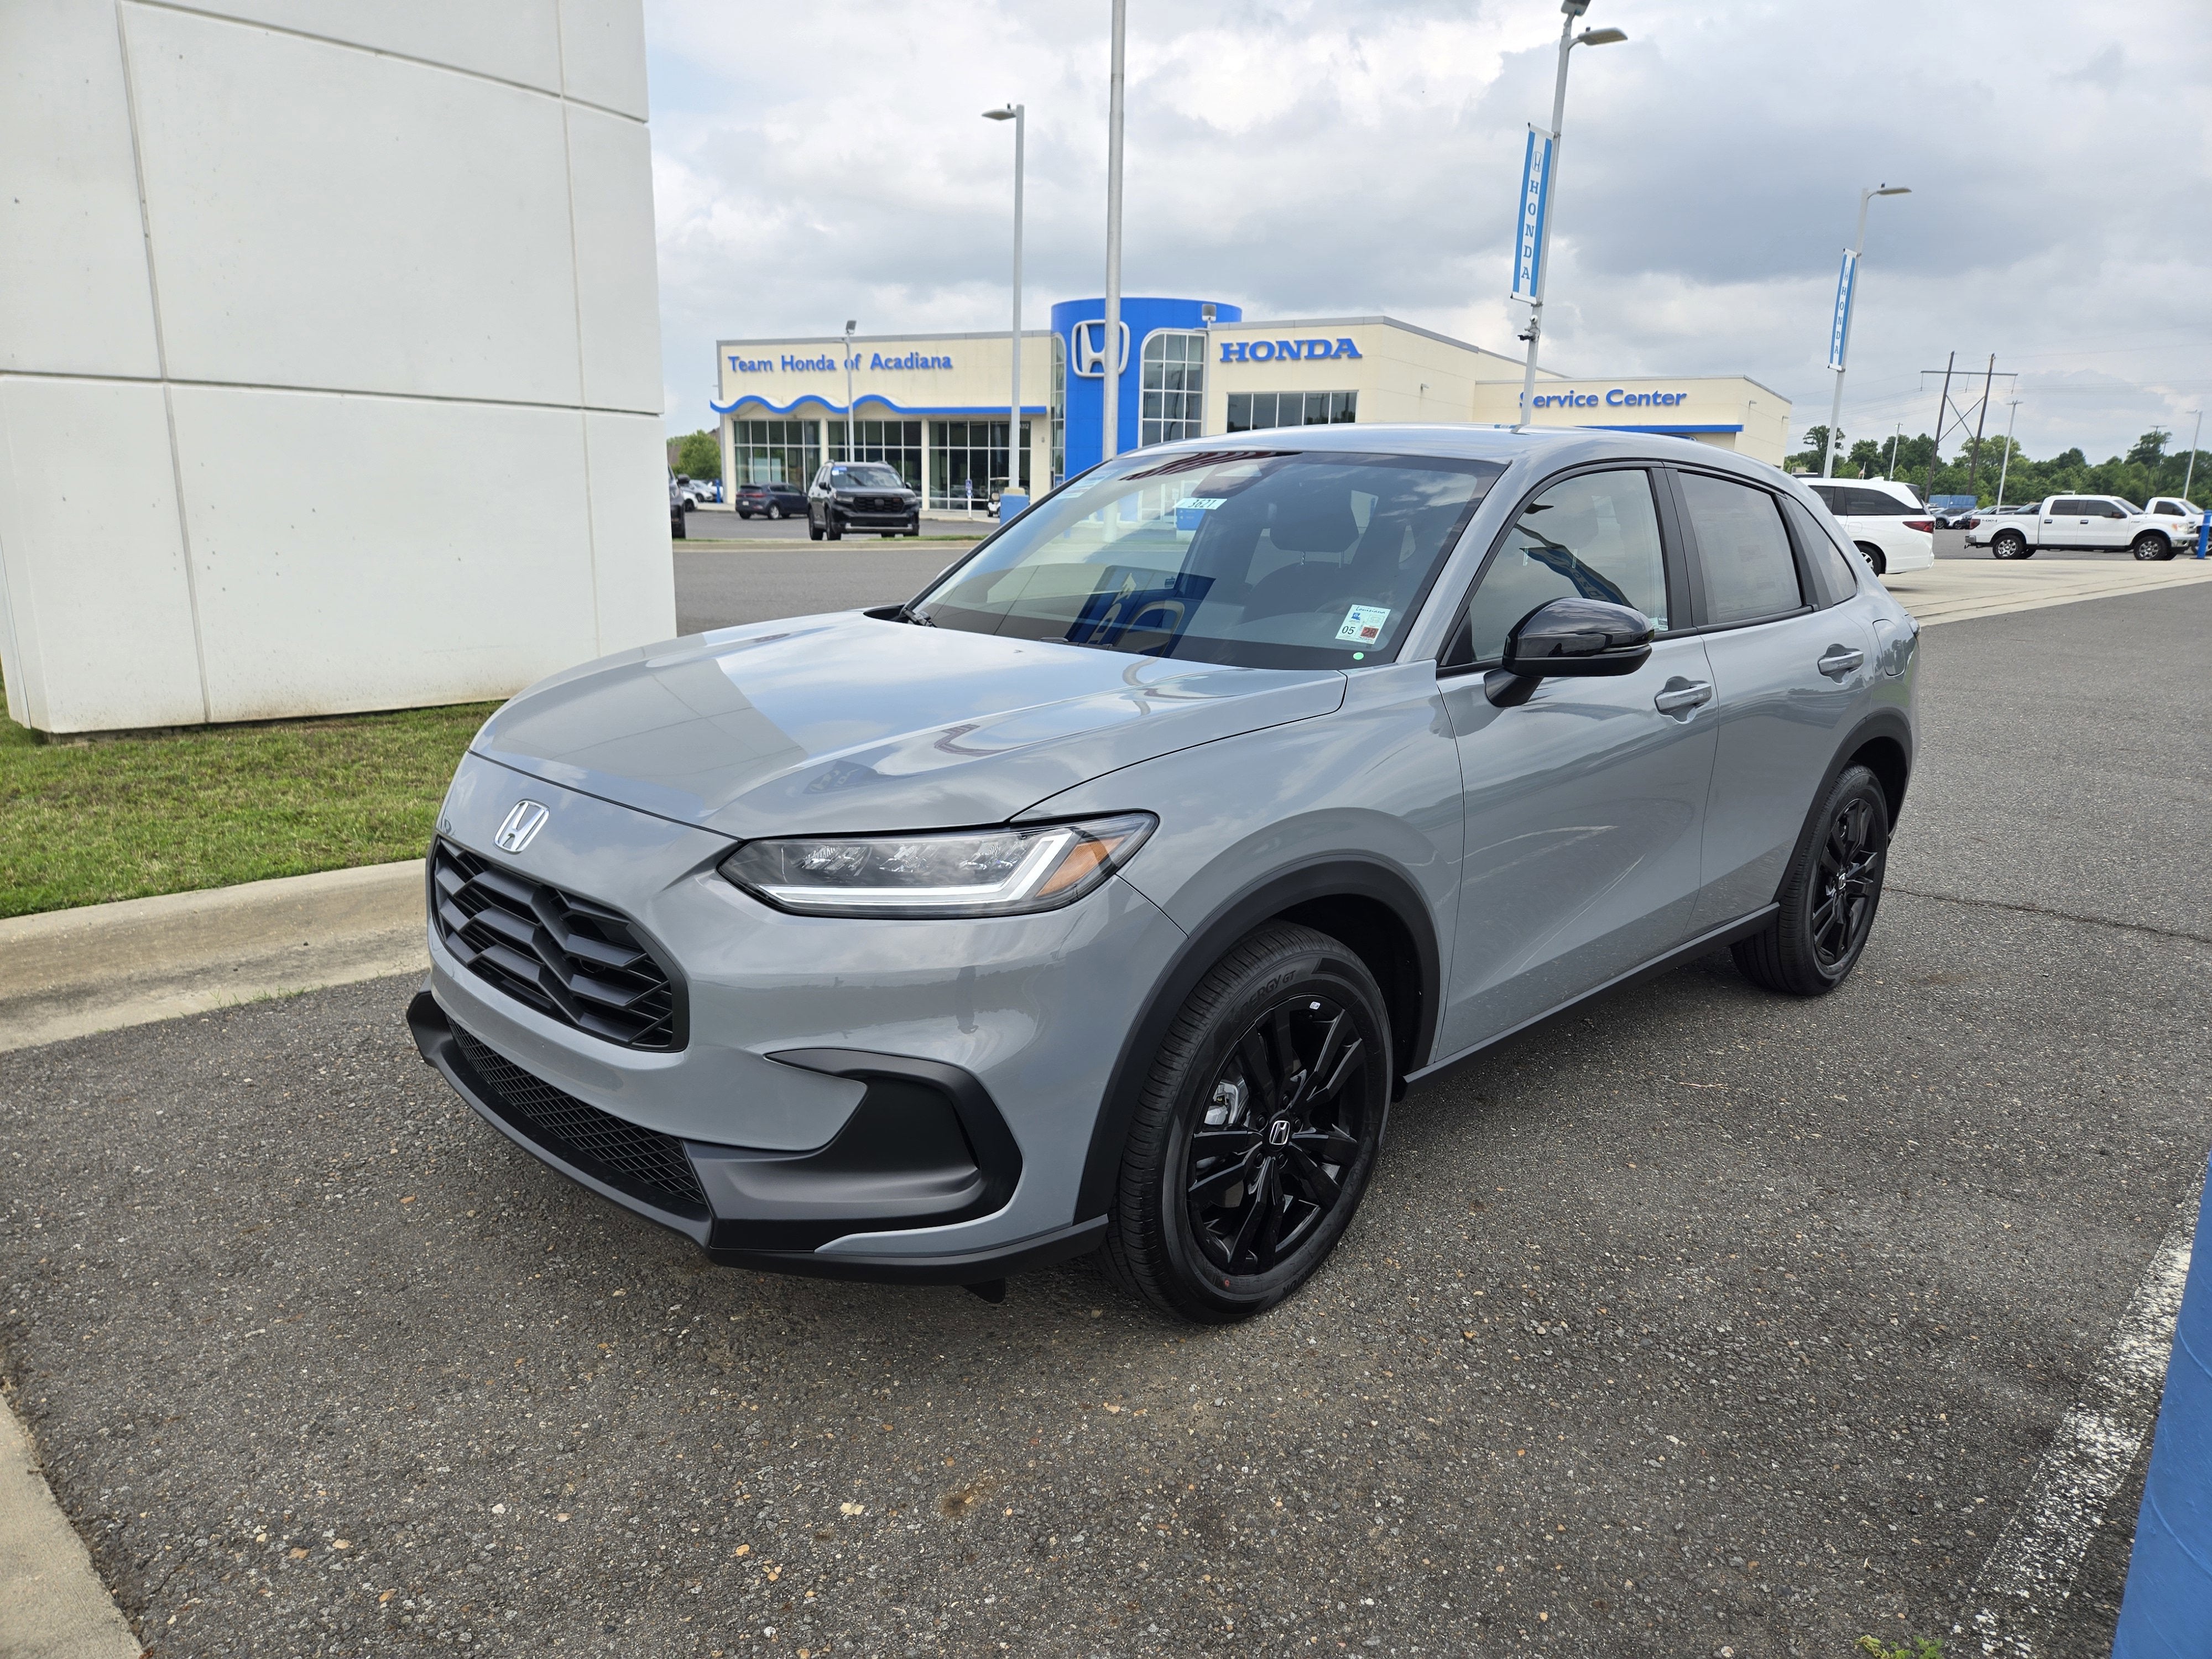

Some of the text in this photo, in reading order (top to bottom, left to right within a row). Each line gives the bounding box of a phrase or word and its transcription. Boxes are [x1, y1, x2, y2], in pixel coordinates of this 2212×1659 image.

[1521, 180, 1540, 280] HONDA
[1834, 286, 1846, 354] HONDA
[1220, 338, 1363, 363] HONDA
[728, 352, 953, 373] Team Honda of Acadiana
[1606, 389, 1687, 406] Center
[1187, 499, 1217, 508] 3621
[1342, 625, 1355, 634] 05
[1282, 971, 1296, 984] GT
